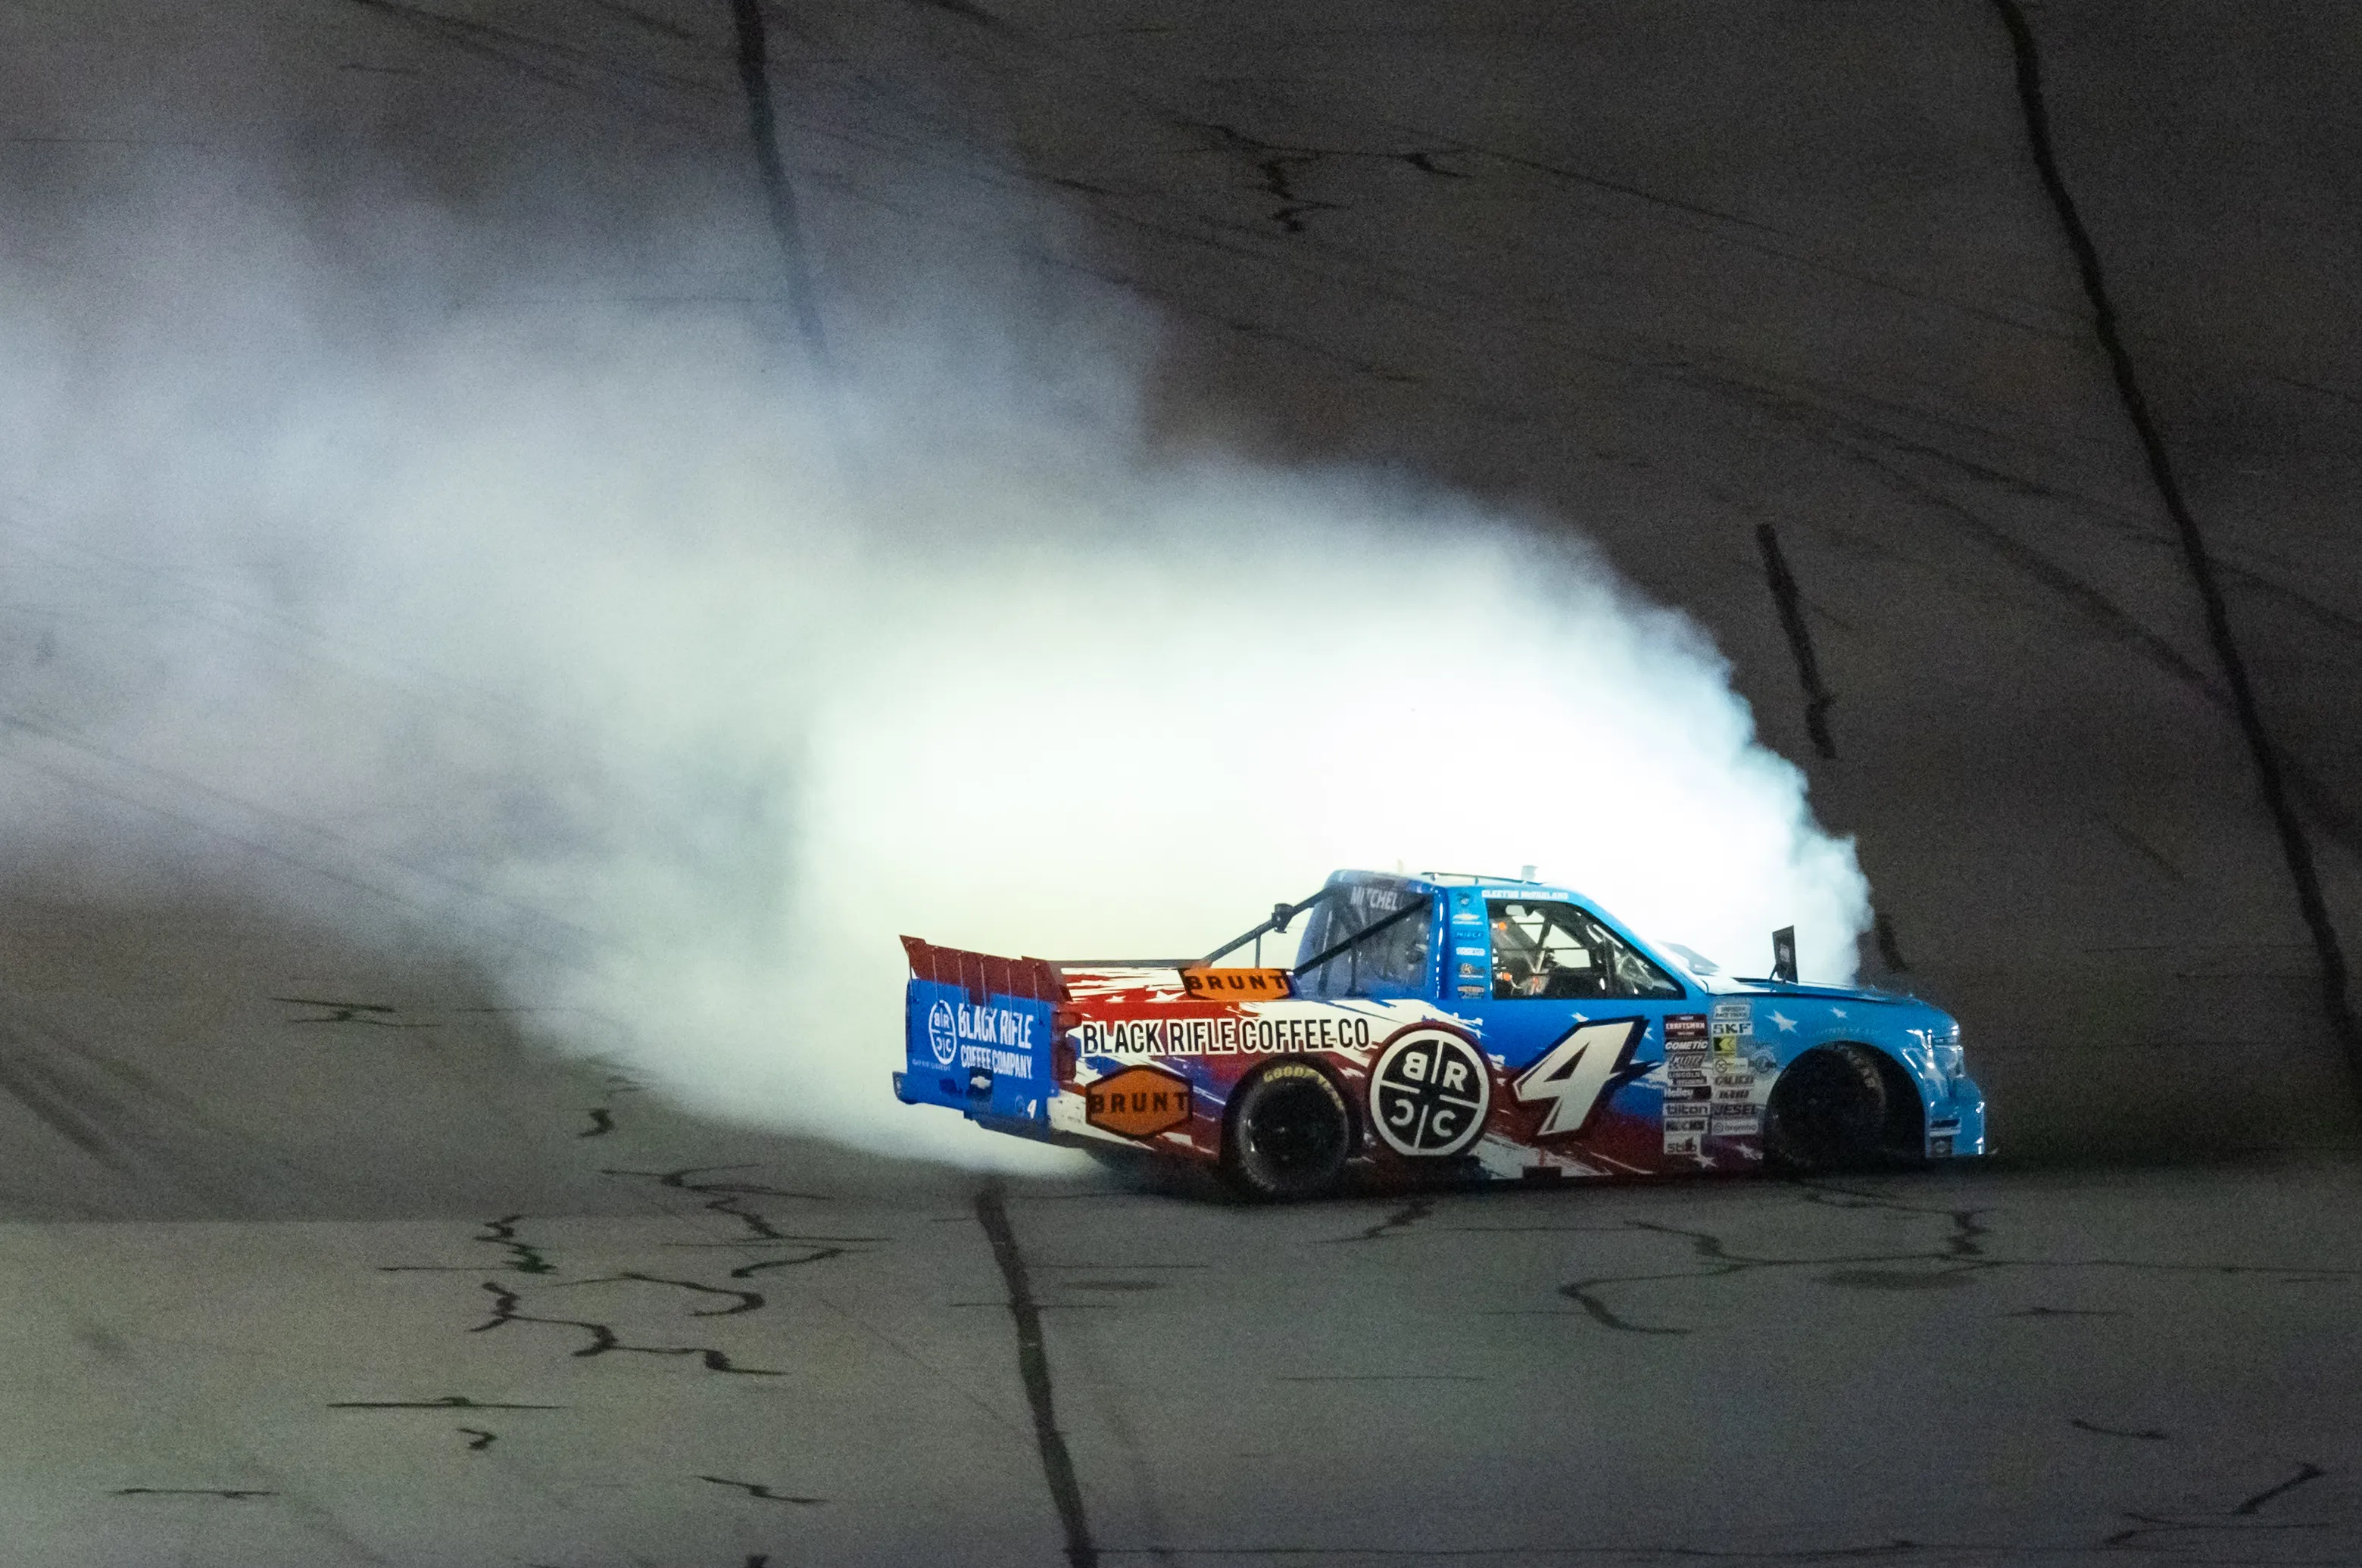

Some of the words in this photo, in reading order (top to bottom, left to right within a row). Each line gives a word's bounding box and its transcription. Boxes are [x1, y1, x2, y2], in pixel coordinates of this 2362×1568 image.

[1185, 974, 1287, 990] BRUNT
[958, 1003, 997, 1043] BLACK
[1000, 1009, 1034, 1049] RIFLE
[1082, 1021, 1163, 1054] BLACK
[1170, 1020, 1236, 1052] RIFLE
[1242, 1019, 1333, 1051] COFFEE
[1338, 1018, 1370, 1048] CO
[1712, 1022, 1752, 1035] SKF
[1665, 1040, 1709, 1051] COMETIC
[960, 1045, 992, 1071] COFFEE
[992, 1049, 1033, 1080] COMPANY
[1512, 1020, 1636, 1136] 4
[1028, 1099, 1037, 1119] 4
[1089, 1093, 1187, 1114] BRUNT
